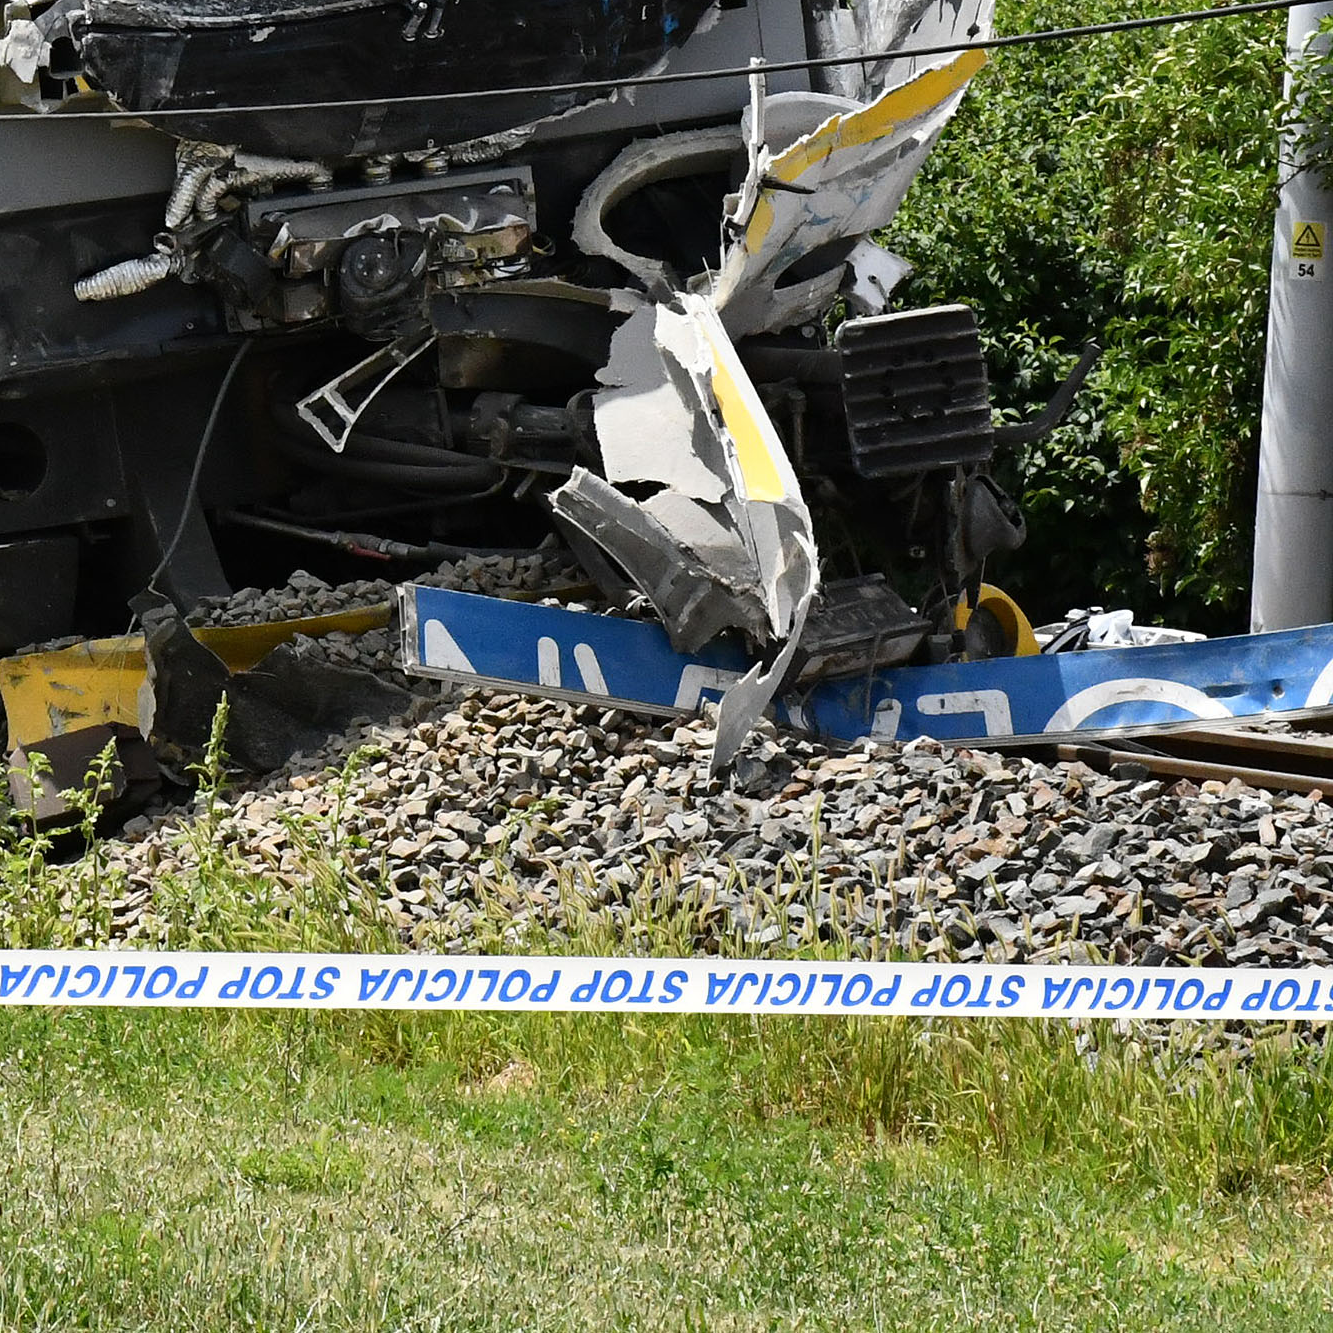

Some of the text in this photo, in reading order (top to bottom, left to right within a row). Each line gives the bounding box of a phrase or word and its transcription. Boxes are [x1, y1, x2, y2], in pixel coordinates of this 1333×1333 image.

[1298, 263, 1315, 277] 54
[0, 965, 209, 999] POLICIJA
[218, 967, 340, 1000] STOP
[359, 969, 561, 1002] POLICIJA
[571, 970, 688, 1003] STOP
[707, 973, 901, 1006] POLICIJA
[911, 975, 1025, 1008] STOP
[1043, 978, 1232, 1010] POLICIJA
